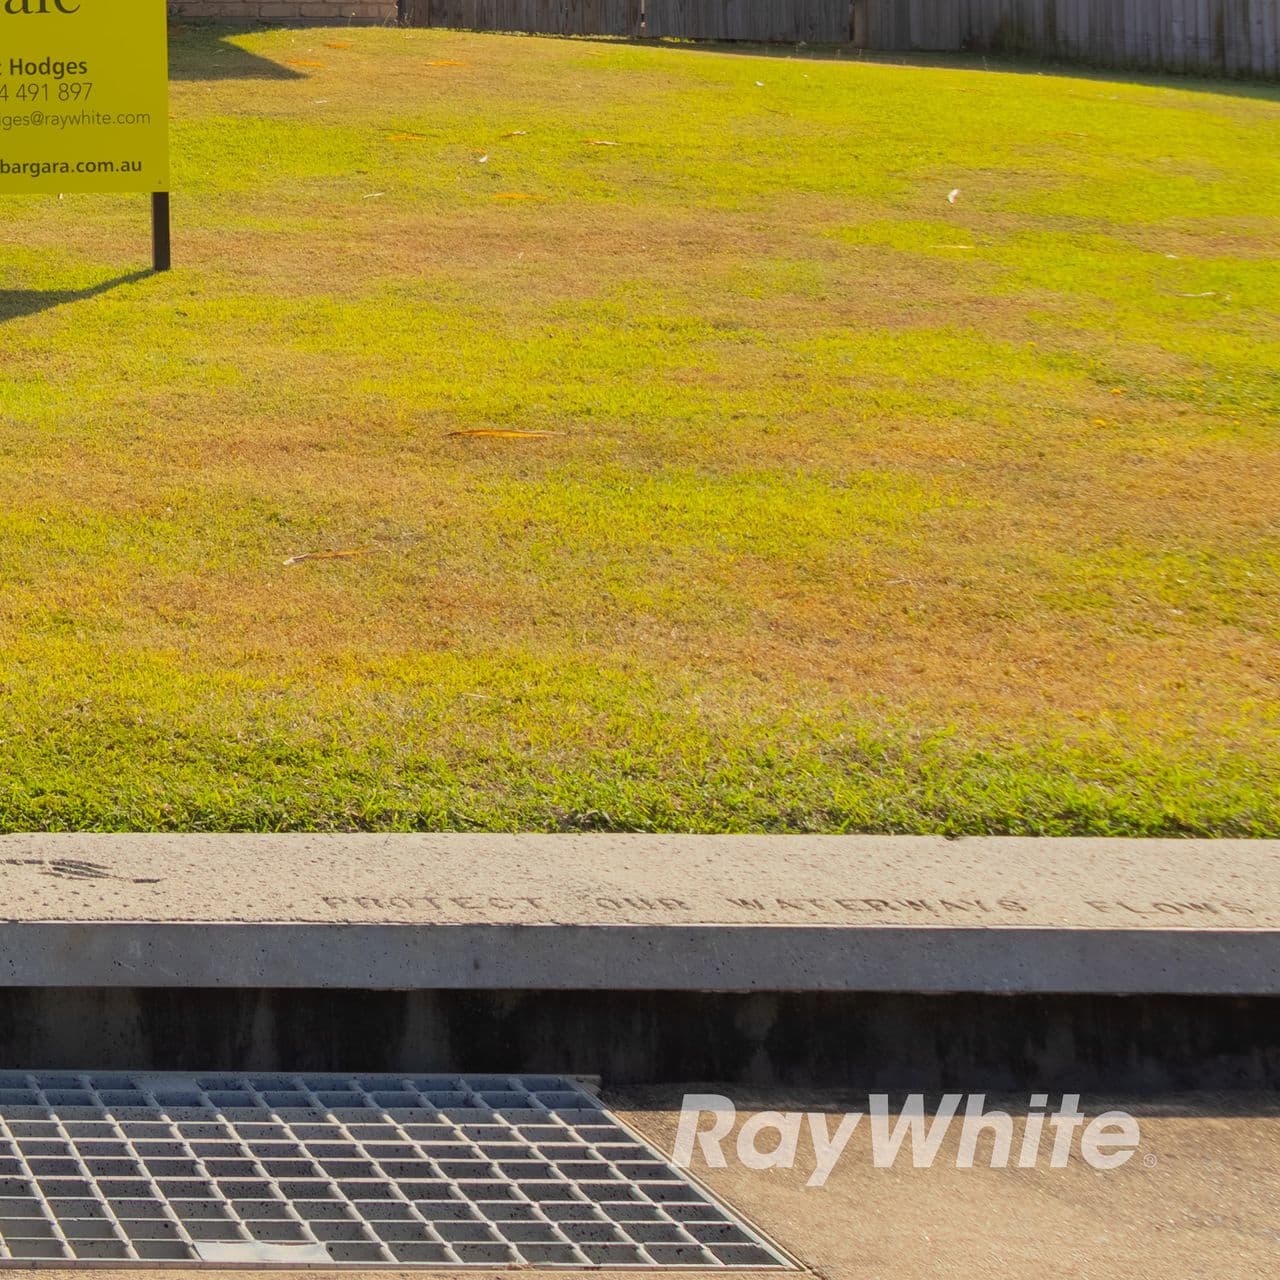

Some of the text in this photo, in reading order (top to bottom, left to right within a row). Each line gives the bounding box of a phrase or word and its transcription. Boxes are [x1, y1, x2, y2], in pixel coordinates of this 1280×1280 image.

[9, 57, 88, 79] Hodges
[16, 83, 49, 101] 491
[58, 82, 93, 101] 897
[322, 896, 543, 910] PROTECT
[595, 897, 690, 910] OUR
[727, 898, 1028, 912] WATERWAYS
